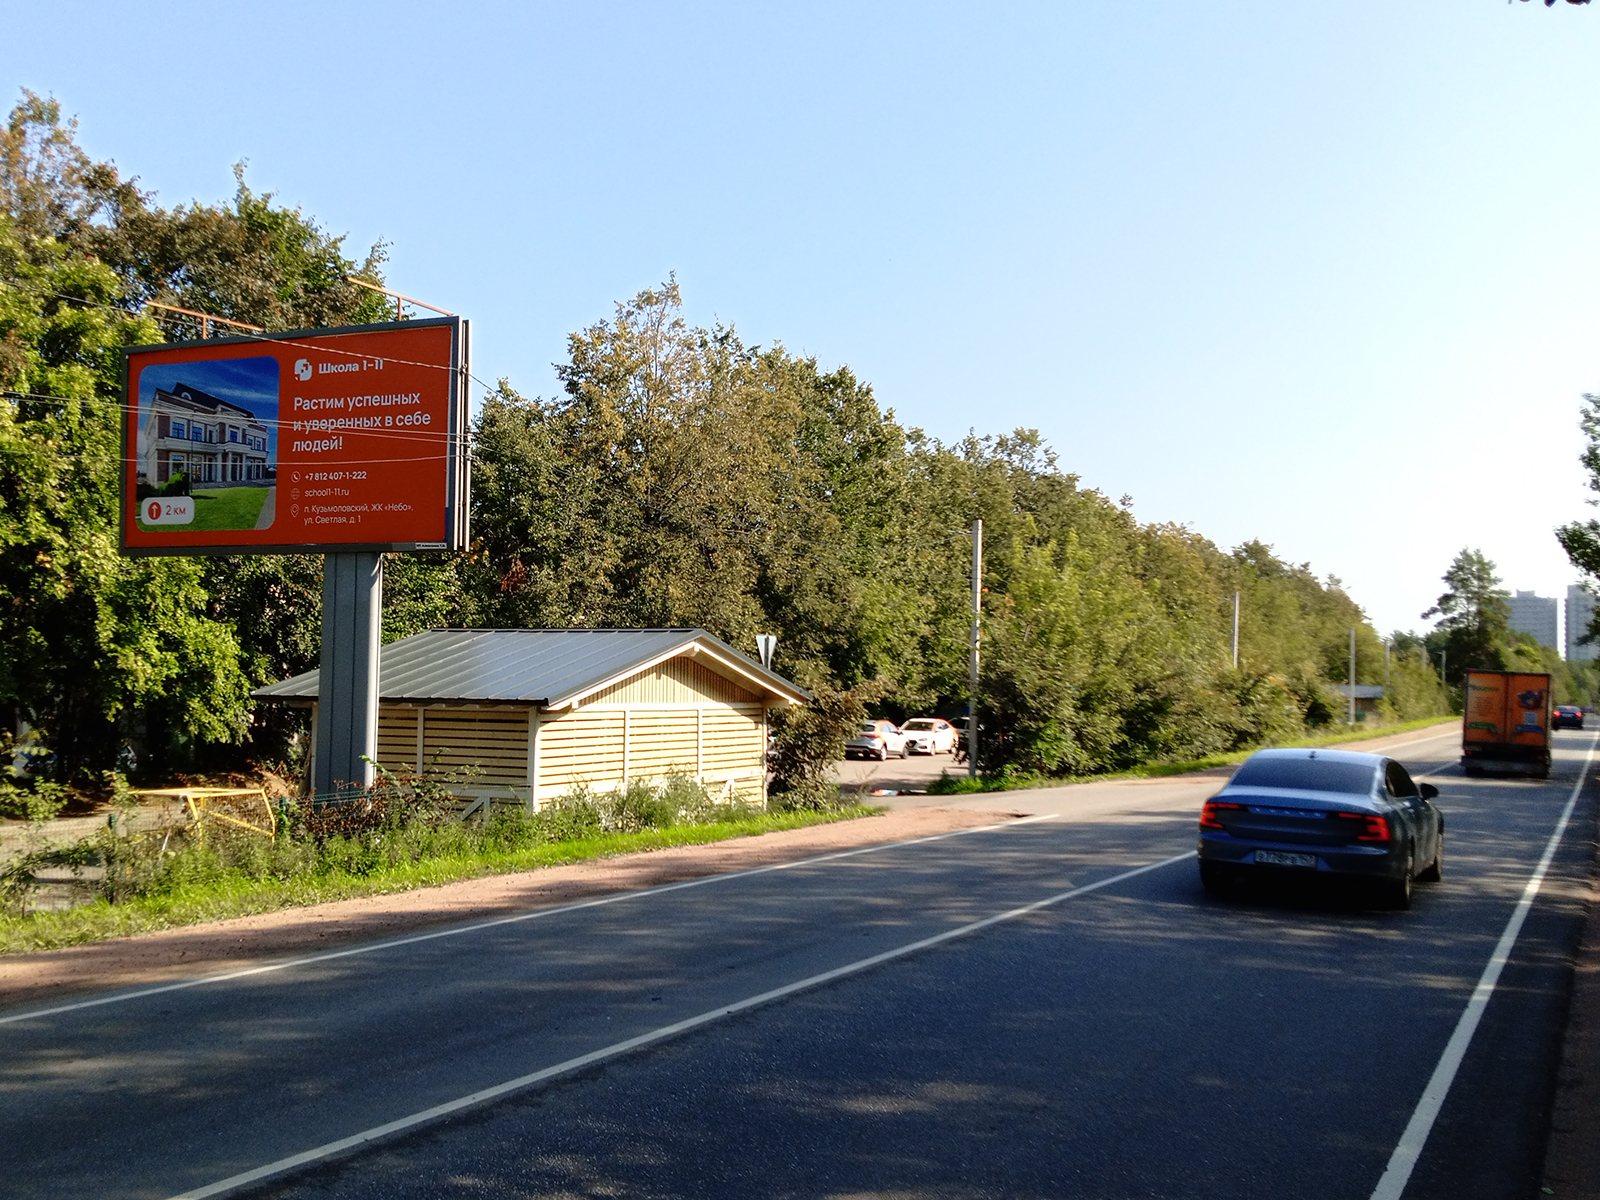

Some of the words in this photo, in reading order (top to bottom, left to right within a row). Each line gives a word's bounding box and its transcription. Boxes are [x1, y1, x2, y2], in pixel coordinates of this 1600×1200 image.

[318, 363, 359, 374] Школа
[363, 359, 384, 371] 1-11
[294, 397, 344, 411] Растим
[347, 393, 421, 411] успешных
[293, 421, 302, 432] и
[305, 416, 382, 434] уверенных
[385, 416, 393, 426] в
[396, 411, 431, 426] себе
[292, 436, 343, 452] людей!
[305, 473, 314, 481] +7
[315, 472, 328, 480] 812
[328, 471, 367, 480] 407-1-222
[304, 488, 350, 497] school1-11.ru
[165, 504, 172, 516] 2
[173, 506, 186, 515] км
[371, 503, 384, 512] ЖК
